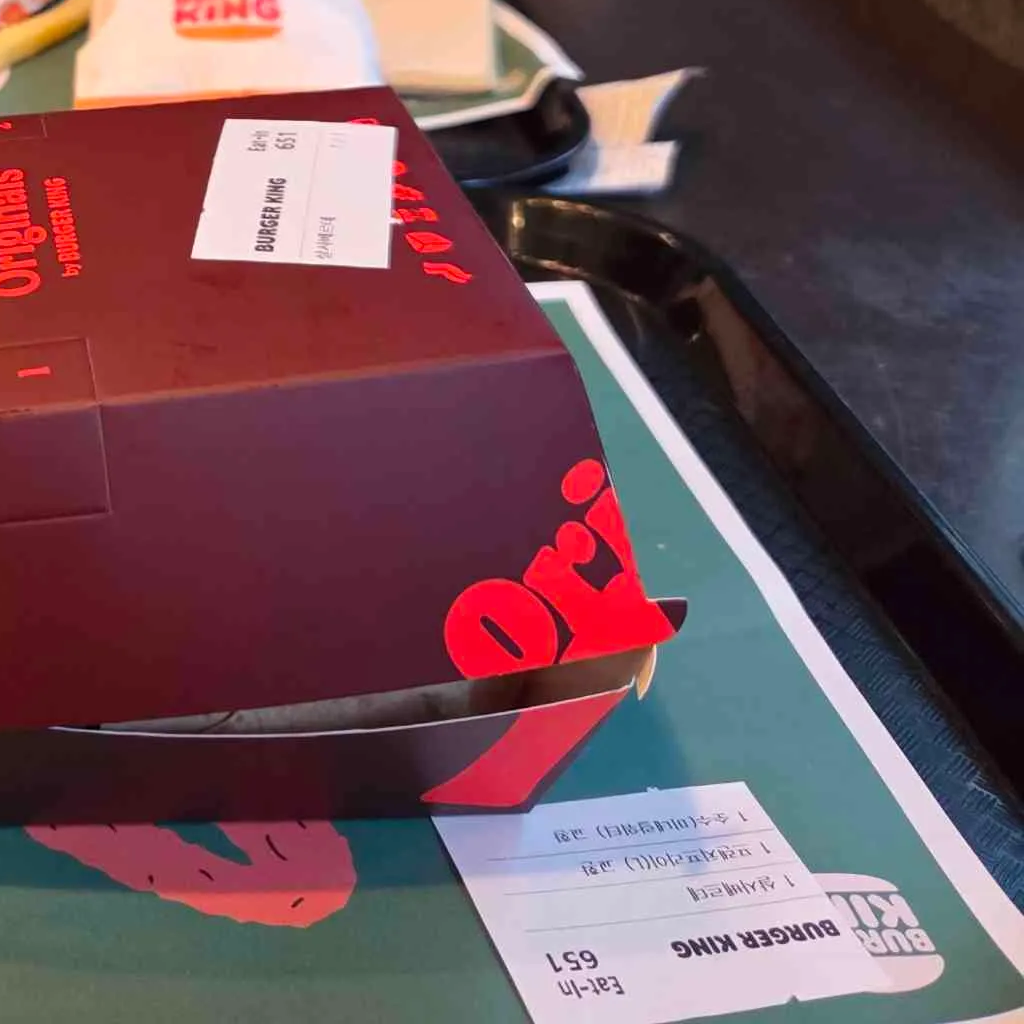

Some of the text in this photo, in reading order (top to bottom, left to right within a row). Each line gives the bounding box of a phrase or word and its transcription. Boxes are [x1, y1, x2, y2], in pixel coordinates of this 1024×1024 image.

[274, 131, 297, 151] 651
[254, 177, 287, 253] BURGER KING
[44, 177, 82, 277] by BURGER KING
[737, 810, 748, 822] 1
[553, 827, 588, 844] 교환
[760, 841, 772, 854] 1
[580, 859, 616, 877] 교환
[783, 874, 795, 888] 1
[670, 919, 841, 959] BURGER KING
[545, 949, 599, 973] 651
[557, 975, 626, 999] Eat-In
